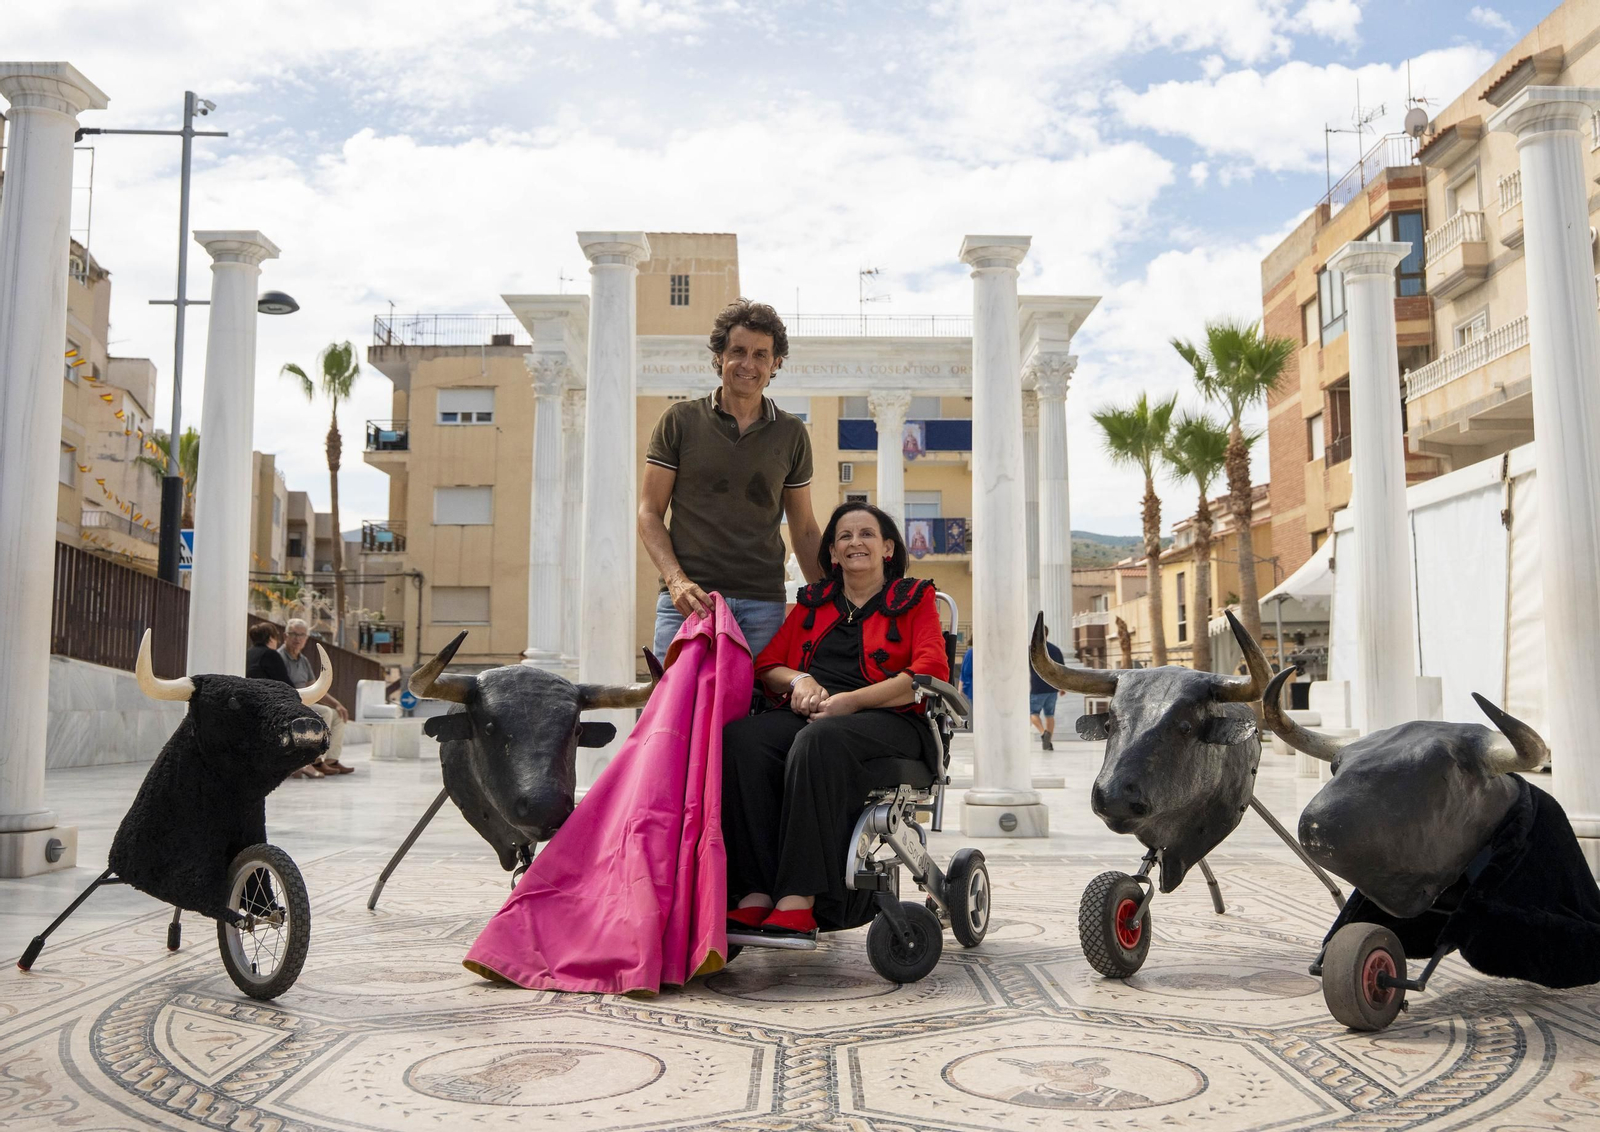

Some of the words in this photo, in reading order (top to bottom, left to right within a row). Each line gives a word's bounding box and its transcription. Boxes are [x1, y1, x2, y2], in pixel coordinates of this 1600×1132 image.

[642, 364, 675, 374] HAEC
[781, 363, 849, 375] NIFICENTIA
[855, 364, 864, 375] A
[869, 364, 941, 375] COSENTINO
